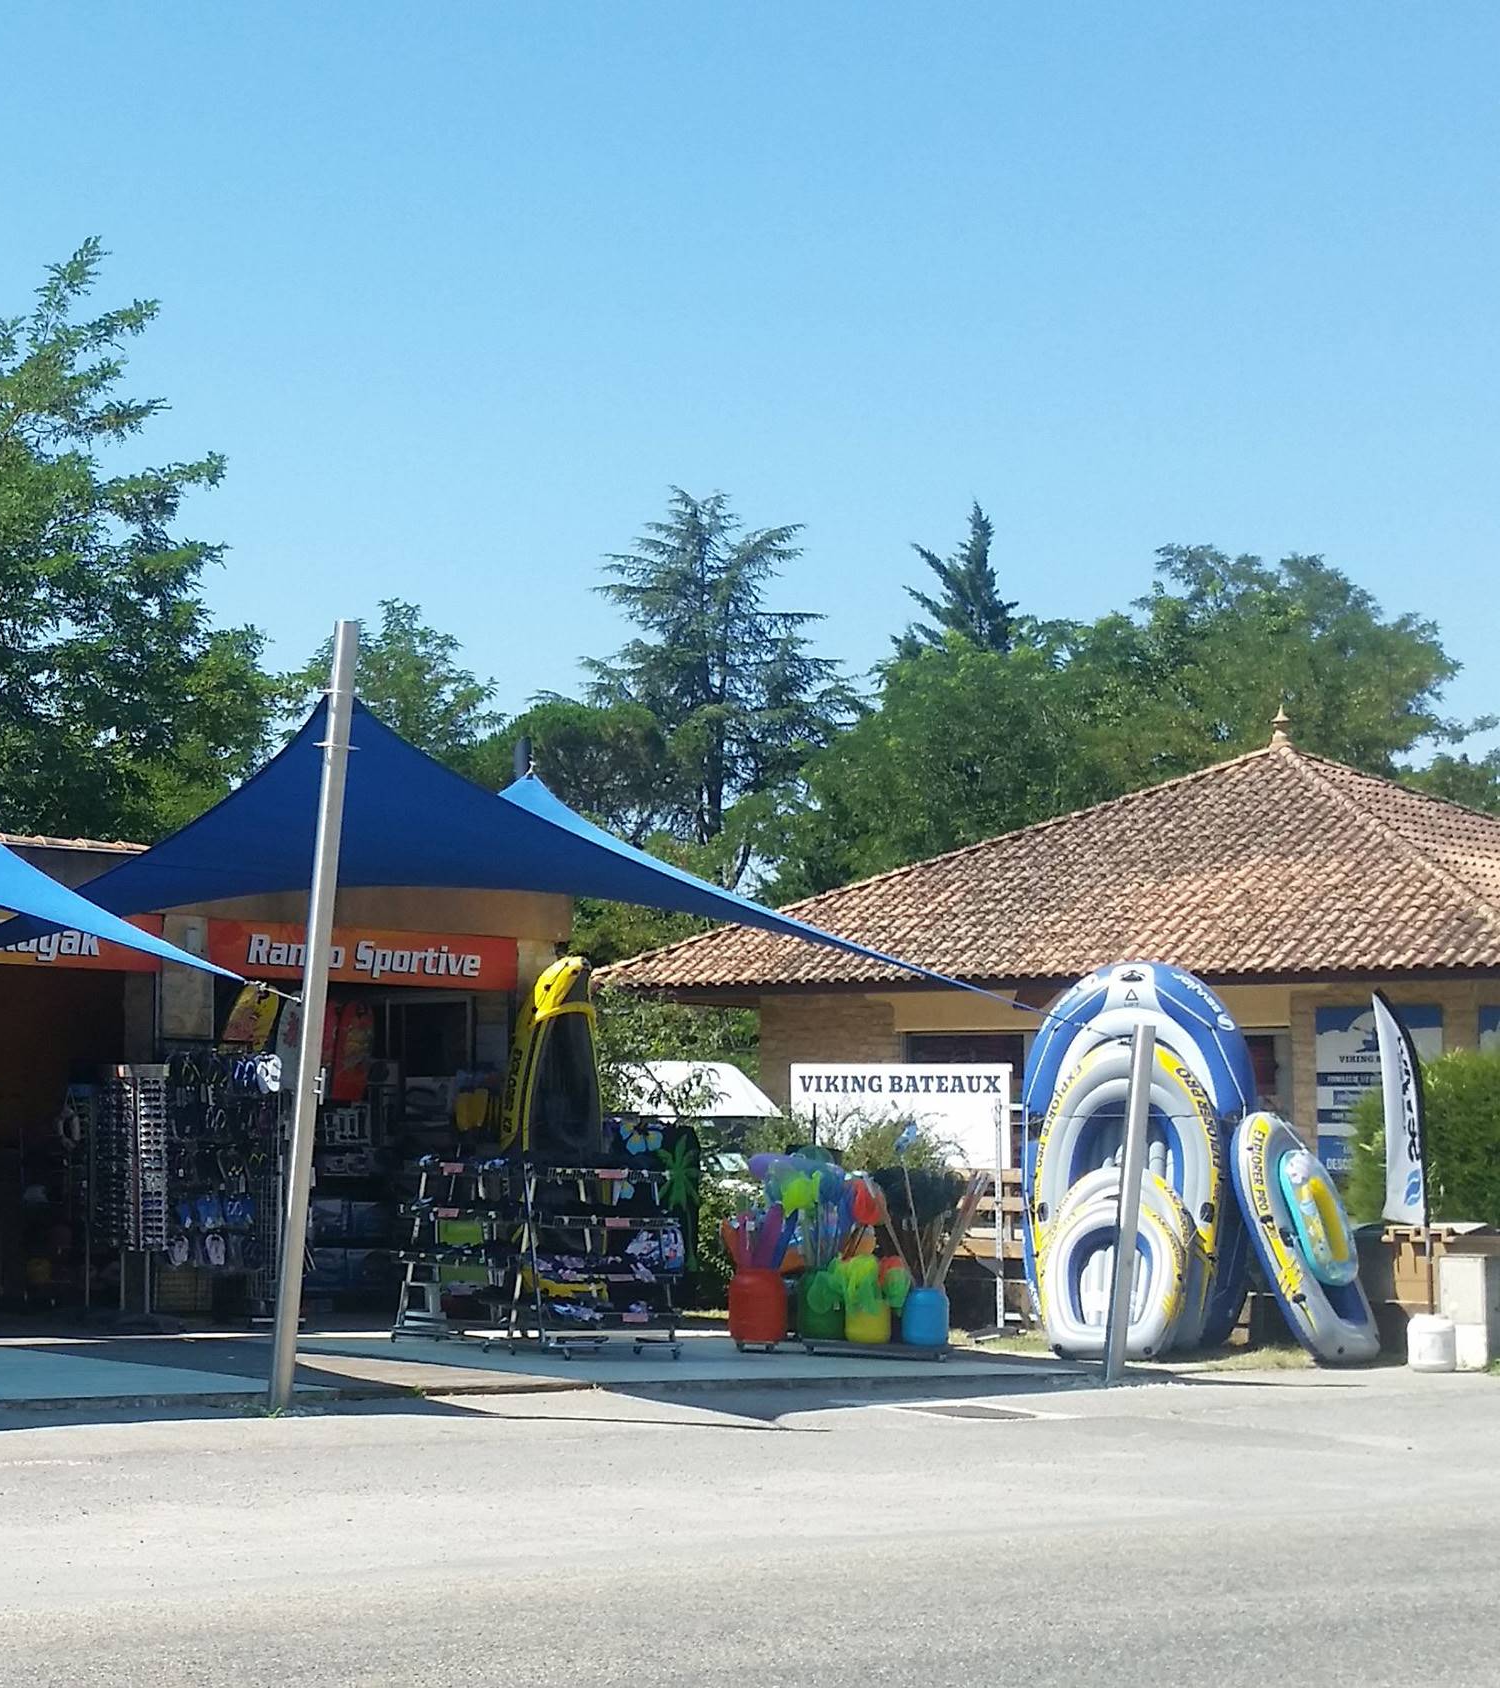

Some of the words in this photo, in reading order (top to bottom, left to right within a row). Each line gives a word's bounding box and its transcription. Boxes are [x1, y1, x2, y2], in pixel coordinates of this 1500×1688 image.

[247, 933, 346, 970] Rano
[355, 940, 482, 979] Sportive
[799, 1075, 883, 1094] VIKING
[888, 1075, 1001, 1094] BATEAUX
[1251, 1129, 1266, 1190] EXPLORER
[1255, 1188, 1269, 1212] PRO
